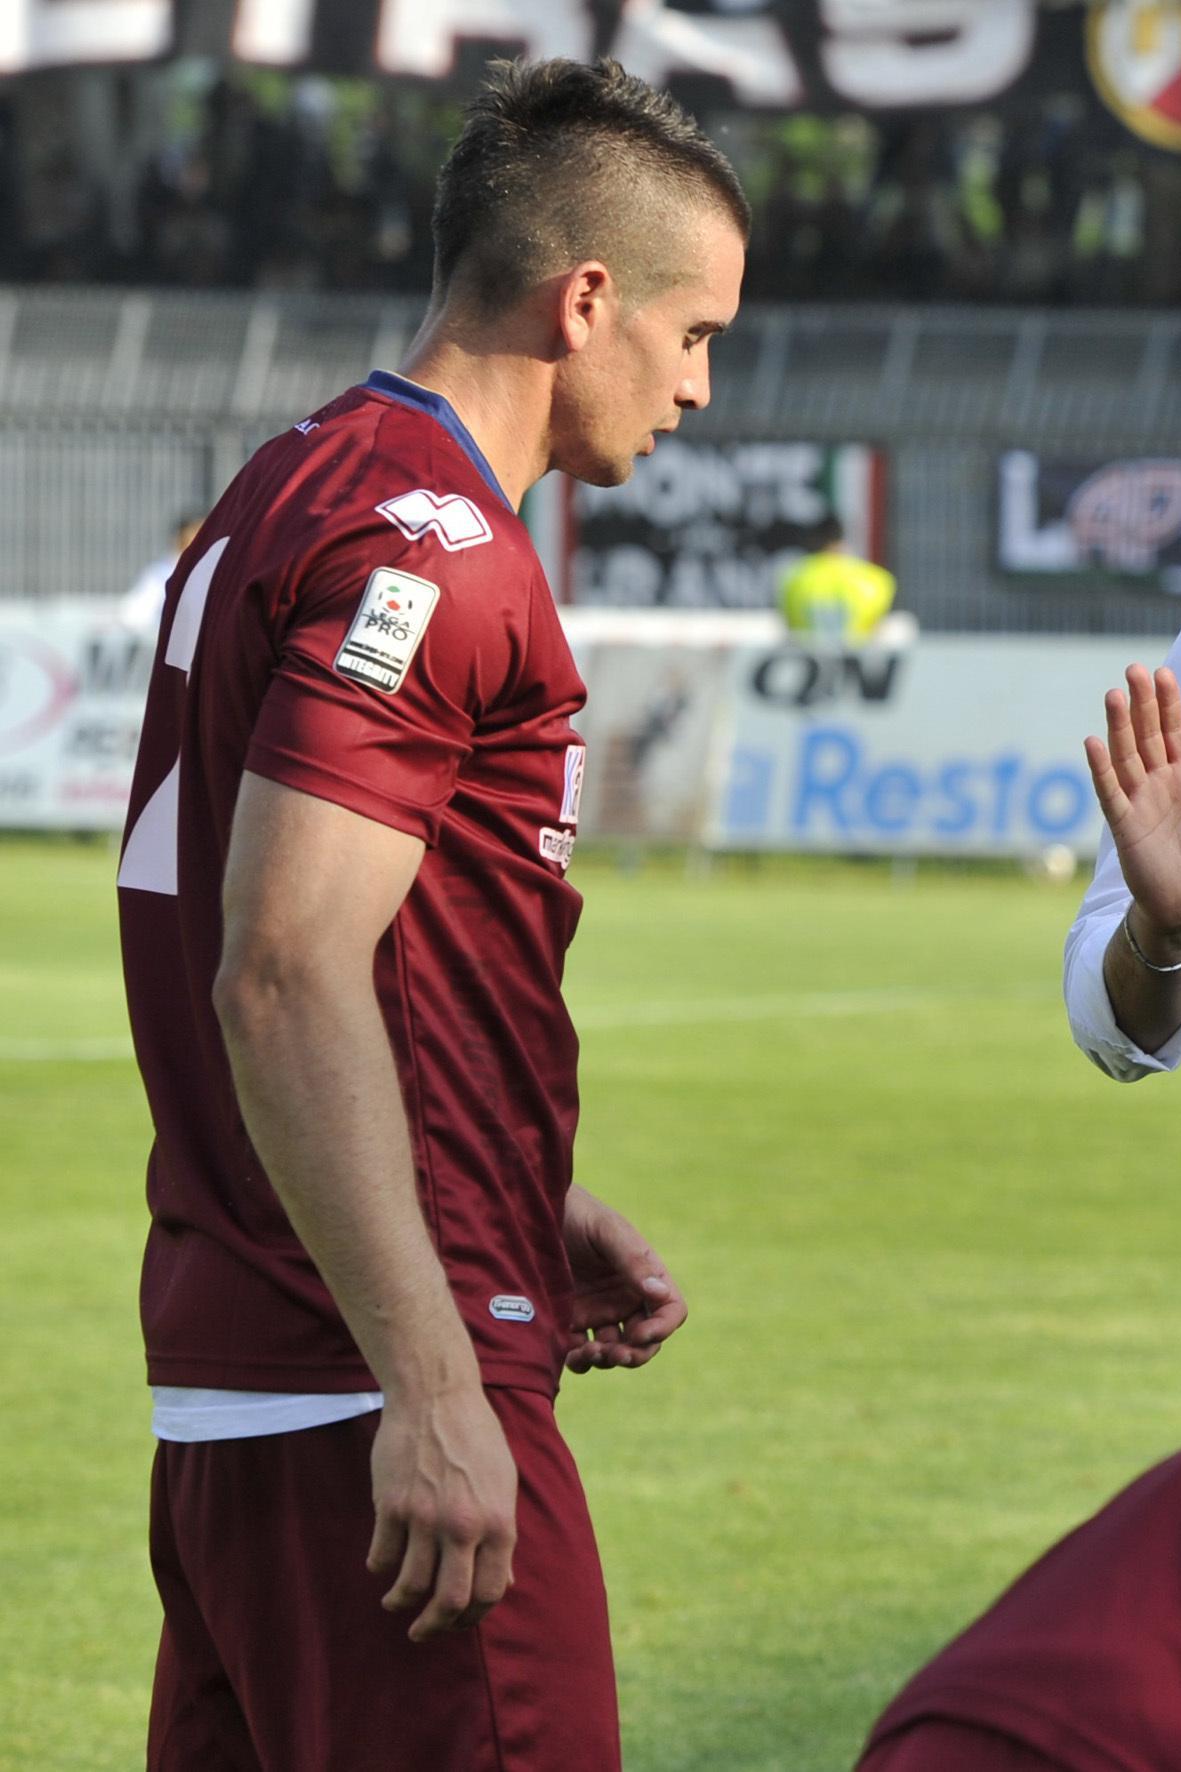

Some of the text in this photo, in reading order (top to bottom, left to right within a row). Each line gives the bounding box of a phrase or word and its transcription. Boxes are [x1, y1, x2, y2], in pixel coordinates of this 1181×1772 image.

[364, 615, 408, 641] PRO
[752, 651, 901, 706] QN
[793, 724, 1092, 836] Resto
